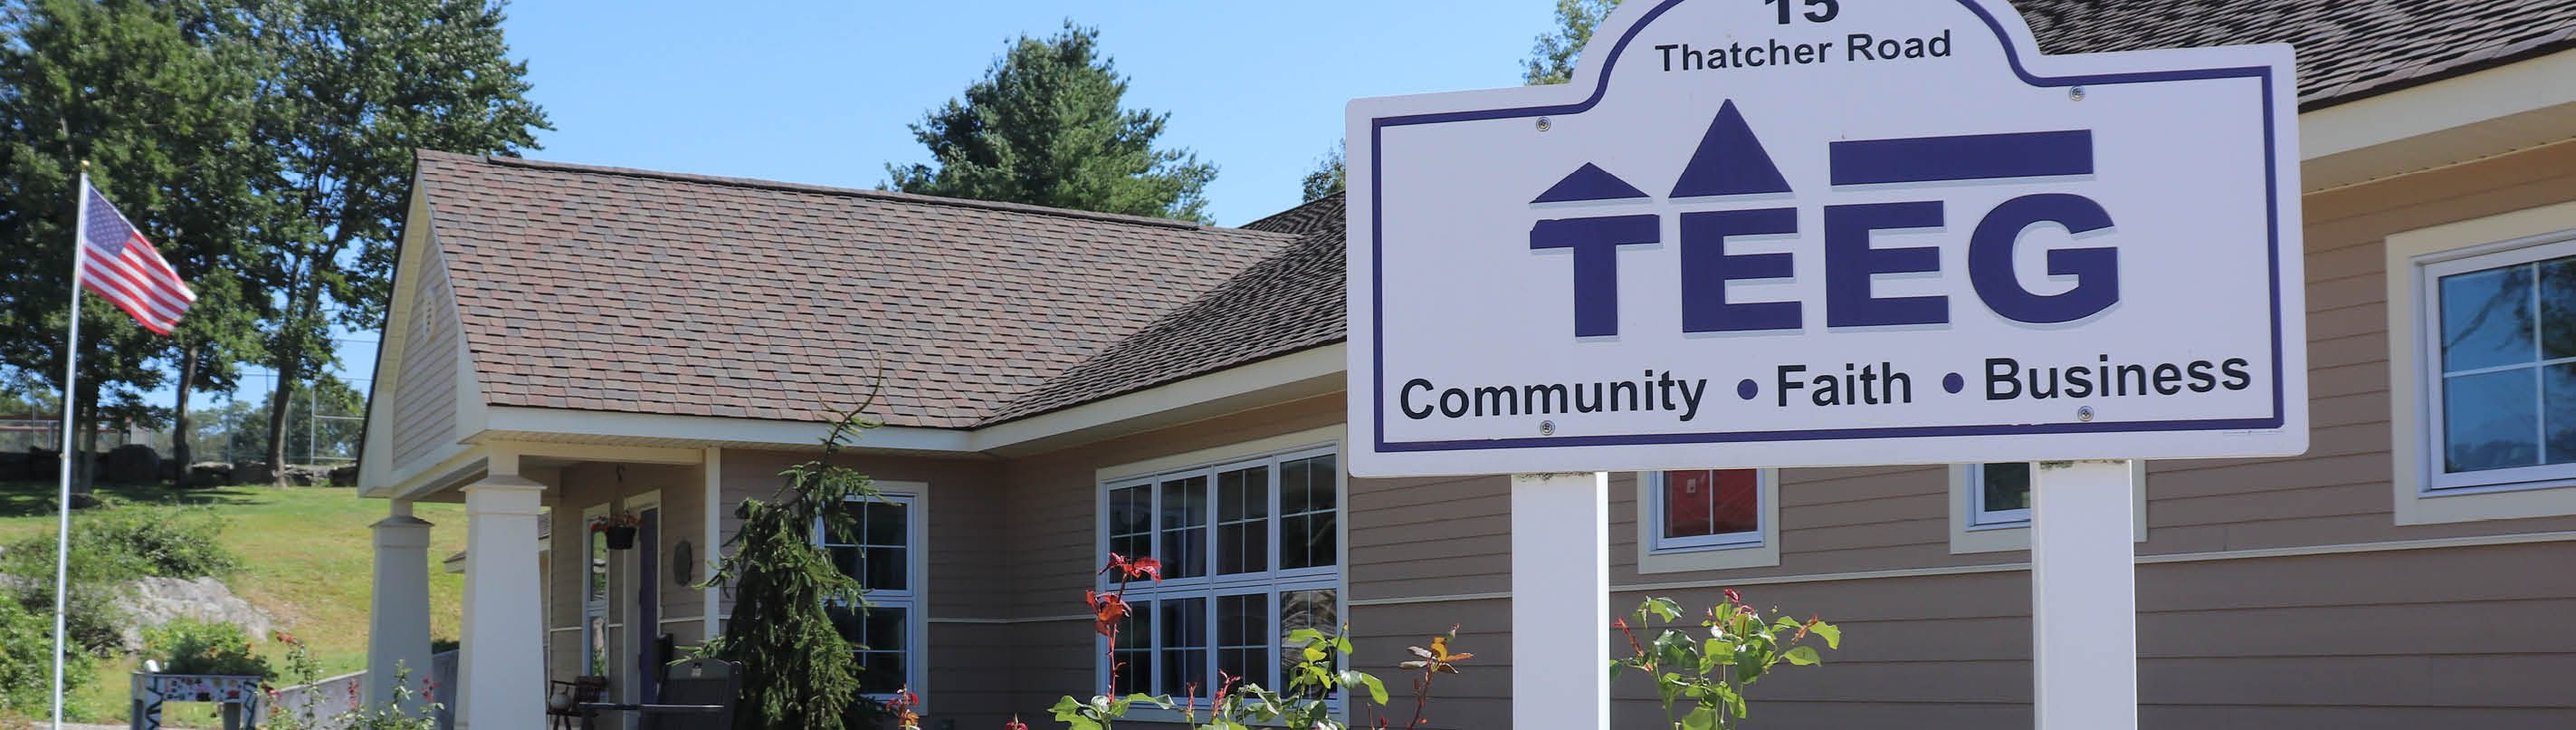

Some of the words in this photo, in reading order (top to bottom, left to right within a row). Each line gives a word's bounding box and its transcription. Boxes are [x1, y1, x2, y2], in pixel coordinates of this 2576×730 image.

[1655, 38, 1833, 72] Thatcher
[1846, 29, 1951, 62] Road
[1529, 193, 2120, 338] TEEG
[1399, 369, 1708, 422] Community
[1777, 361, 1913, 408] Faith
[1984, 353, 2251, 401] Business
